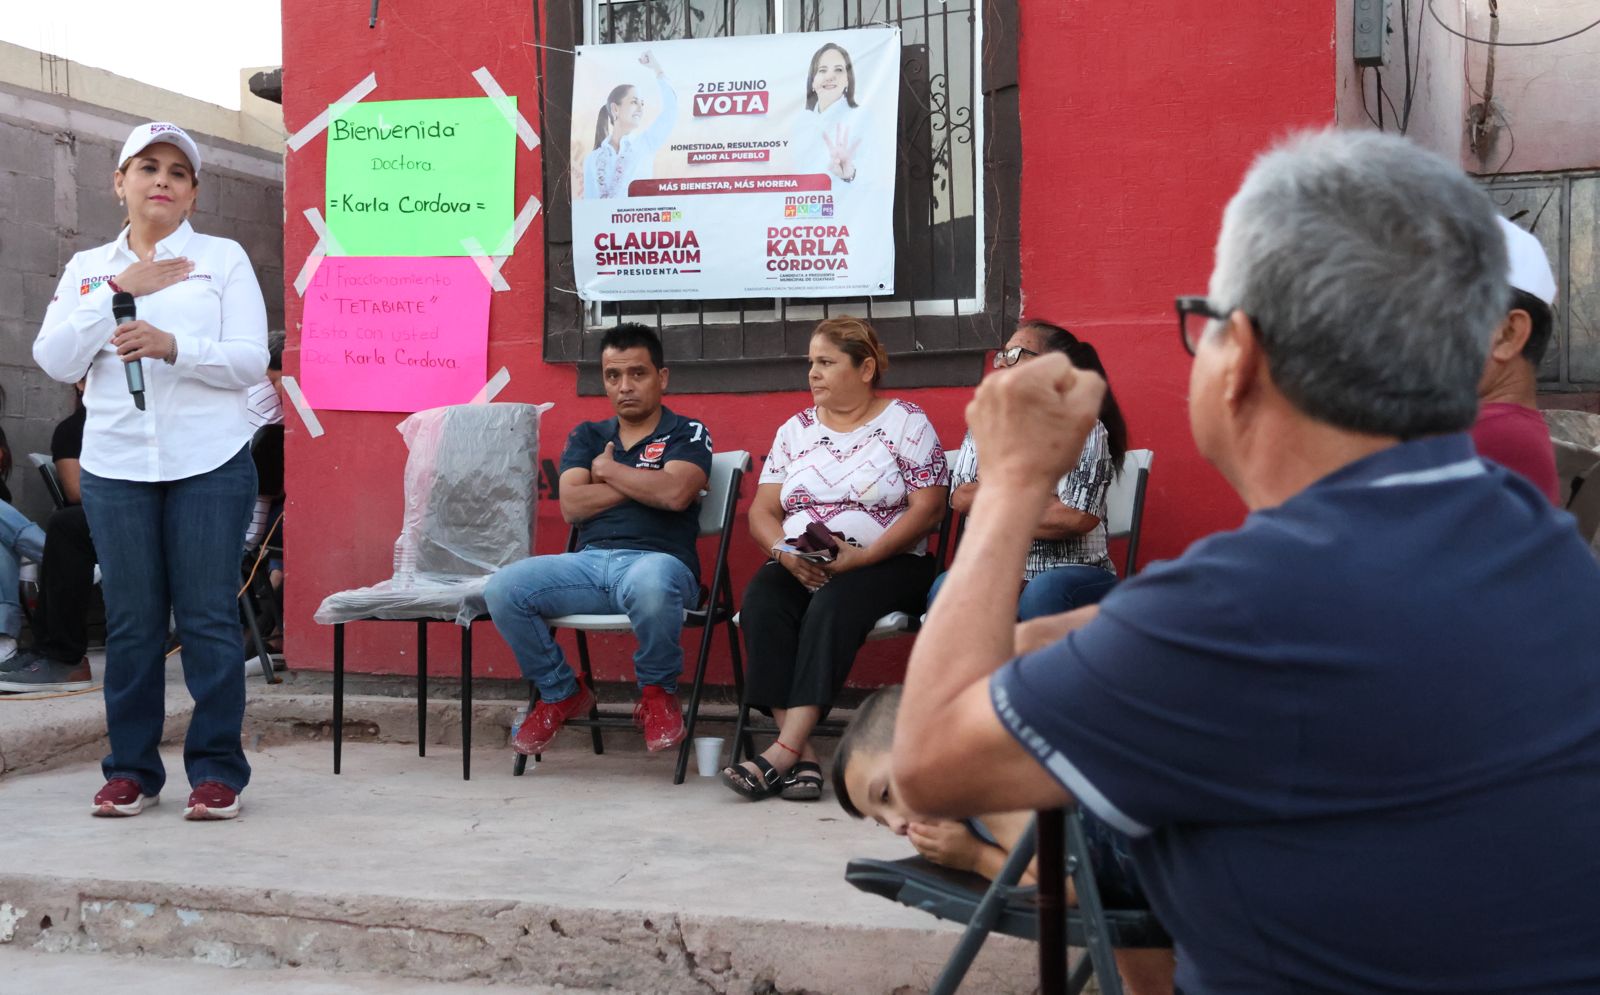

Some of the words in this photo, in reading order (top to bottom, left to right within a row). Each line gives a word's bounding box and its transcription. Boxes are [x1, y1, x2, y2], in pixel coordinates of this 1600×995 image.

[697, 83, 705, 93] 2
[707, 82, 726, 92] DE
[728, 80, 767, 91] JUNIO
[696, 95, 765, 114] VOTA
[671, 143, 726, 151] HONESTIDAD,
[692, 153, 717, 161] AMOR
[659, 180, 678, 191] MÁS
[680, 182, 732, 191] BIENESTAR,
[734, 178, 755, 189] MÁS
[757, 180, 798, 188] MORENA
[342, 194, 389, 213] Karla
[398, 193, 471, 213] Cordova
[785, 194, 833, 205] morena
[611, 211, 660, 223] morena
[767, 226, 849, 238] DOCTORA
[594, 231, 700, 251] CLAUDIA
[766, 239, 849, 256] KARLA
[595, 250, 700, 266] SHEINBAUM
[766, 257, 848, 271] CÓRDOVA
[337, 265, 451, 286] Fraccionamiento
[617, 268, 679, 276] PRESIDENTA
[357, 328, 384, 340] con
[392, 327, 439, 341] usted
[345, 348, 386, 365] Karla
